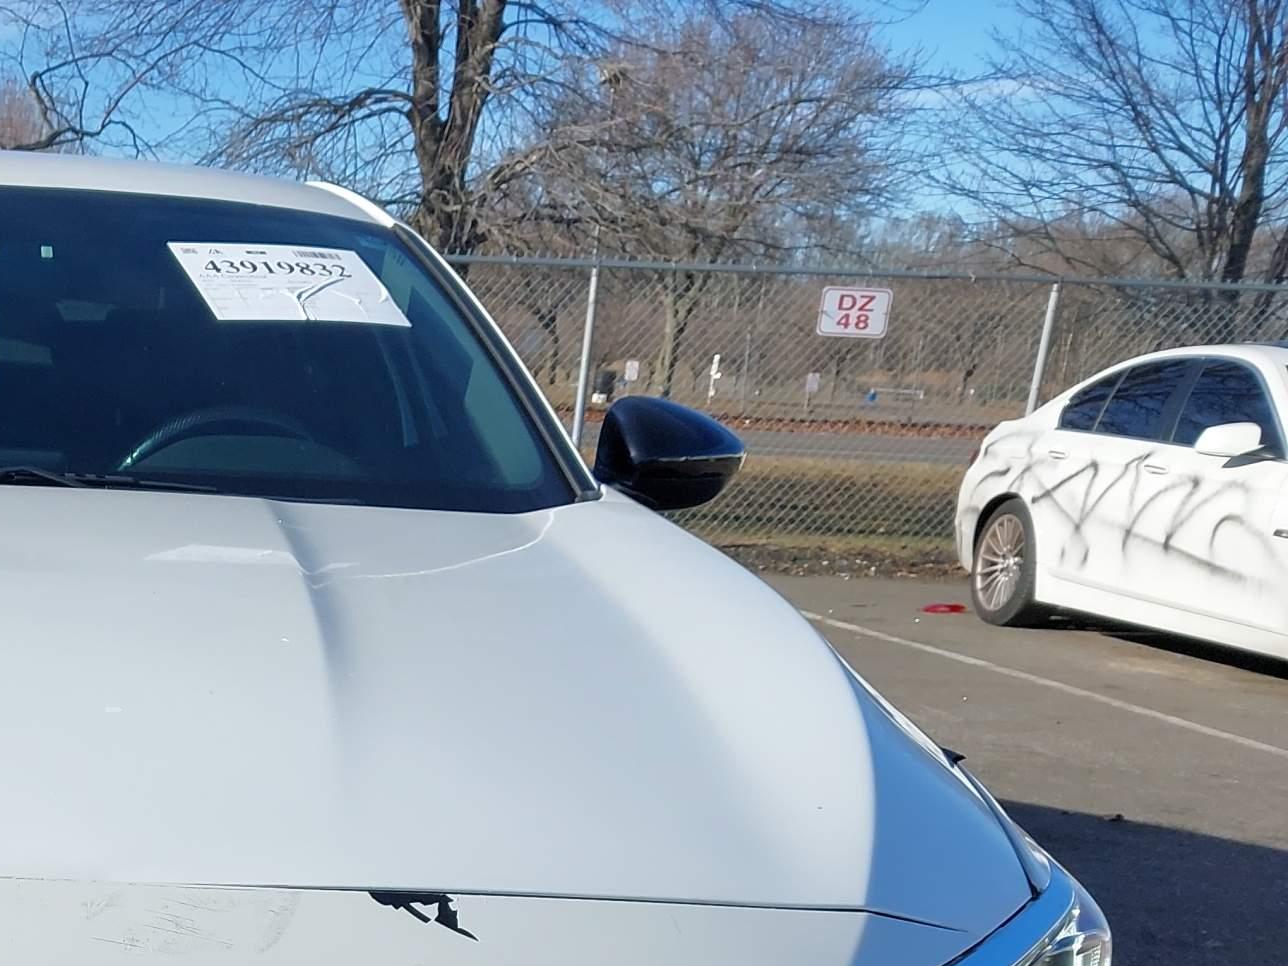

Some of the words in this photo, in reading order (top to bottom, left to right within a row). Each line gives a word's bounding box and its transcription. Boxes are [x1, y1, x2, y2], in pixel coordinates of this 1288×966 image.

[204, 259, 353, 278] 43919832
[838, 293, 877, 312] DZ
[836, 313, 870, 330] 48
